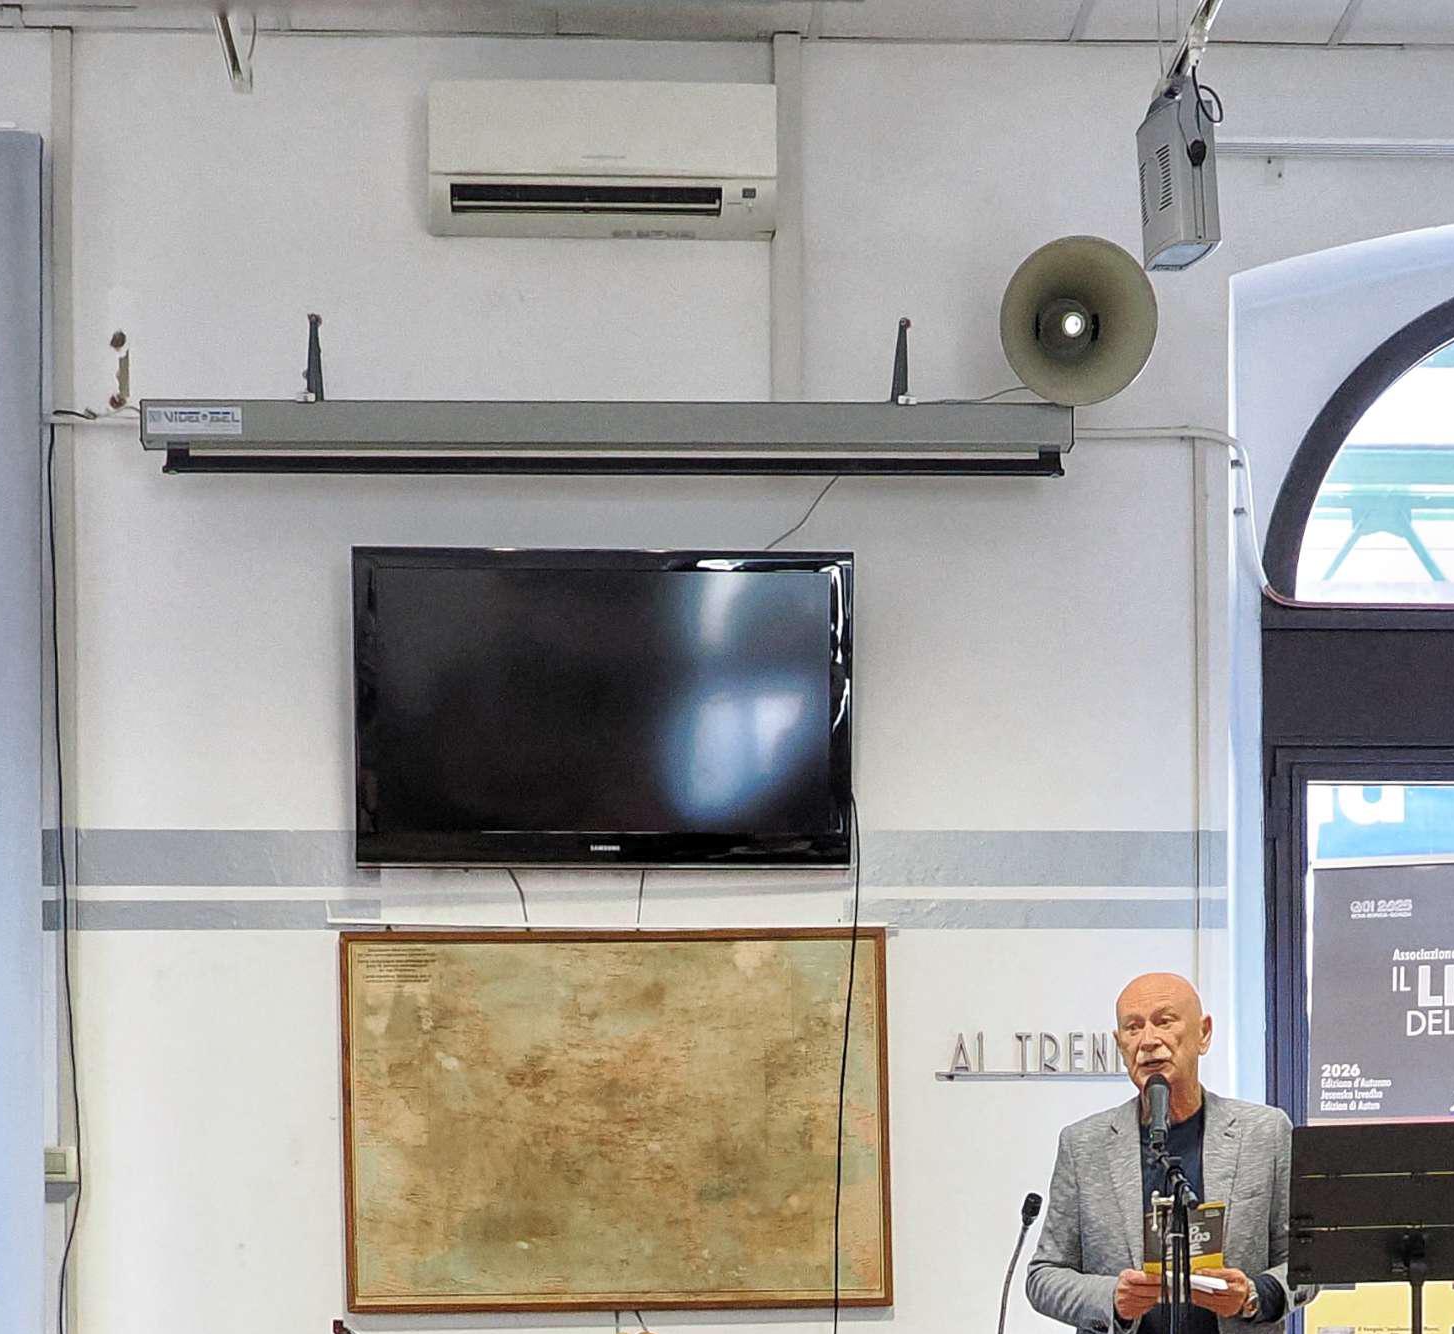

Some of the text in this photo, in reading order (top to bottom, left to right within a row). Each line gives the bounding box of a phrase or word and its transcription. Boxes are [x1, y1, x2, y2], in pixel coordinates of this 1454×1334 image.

[1392, 965, 1411, 992] IL
[950, 1031, 984, 1072] AI
[1321, 1064, 1361, 1077] 2026
